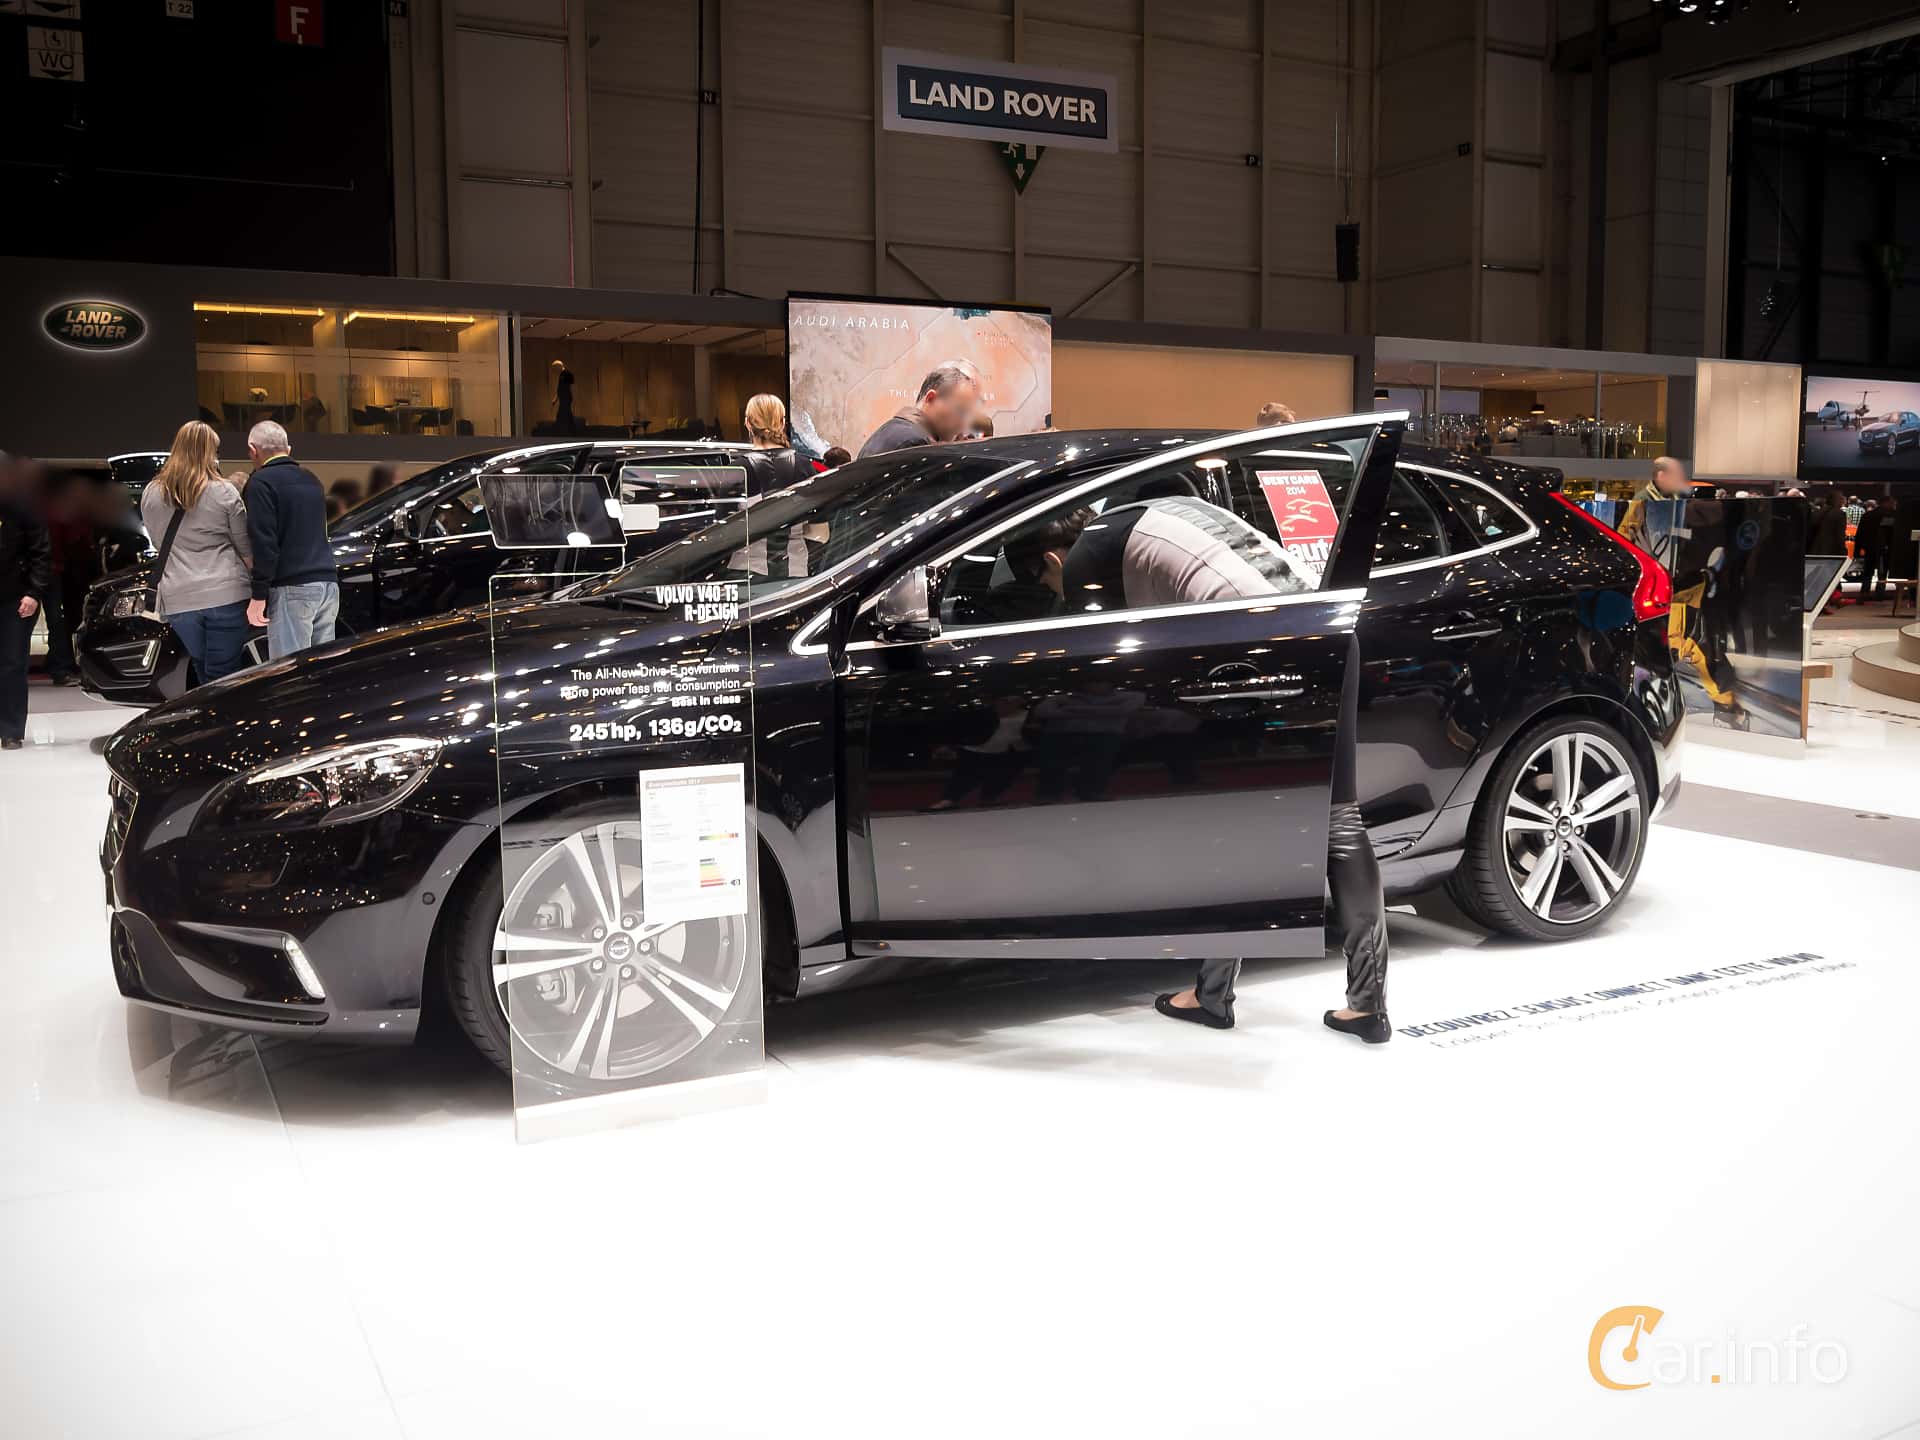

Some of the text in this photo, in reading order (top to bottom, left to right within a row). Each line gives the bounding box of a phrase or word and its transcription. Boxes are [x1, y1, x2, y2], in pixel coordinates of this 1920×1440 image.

[290, 6, 309, 34] F
[39, 52, 74, 70] WC
[909, 79, 1097, 123] LAND ROVER
[65, 310, 112, 324] LAND
[845, 318, 911, 329] ARABIA
[70, 324, 127, 338] ROVER
[1286, 486, 1306, 495] 2014
[1287, 539, 1333, 562] aut
[656, 584, 738, 604] VOLVO V40 T5
[684, 603, 739, 621] R-DESIGN
[571, 669, 592, 681] The
[681, 662, 740, 678] powertrains
[592, 685, 625, 699] power
[628, 684, 649, 695] less
[675, 678, 740, 693] consumption
[672, 694, 741, 707] Best in class
